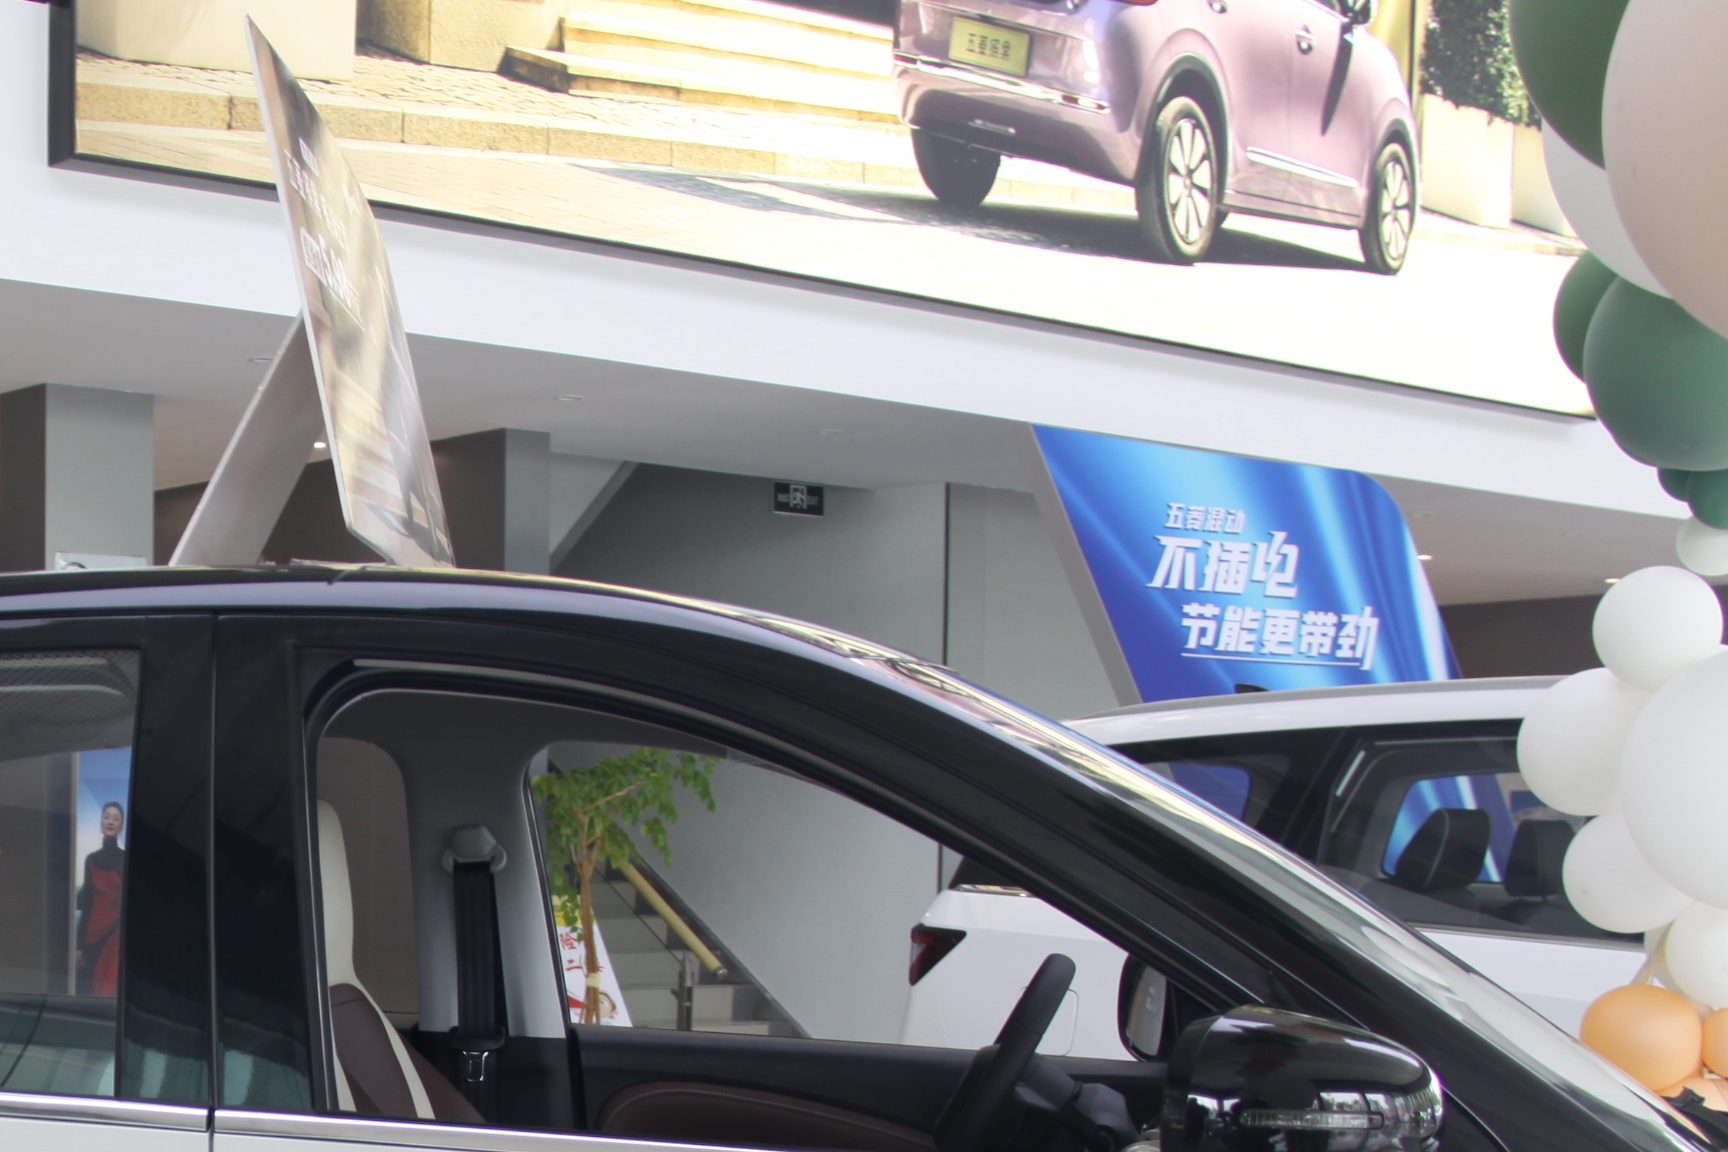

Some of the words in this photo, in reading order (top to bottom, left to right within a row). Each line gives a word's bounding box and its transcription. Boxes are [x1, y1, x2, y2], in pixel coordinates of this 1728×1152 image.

[1165, 502, 1246, 534] 五菱混动
[1146, 530, 1300, 598] 不插电
[1180, 601, 1380, 671] 节能更带劲
